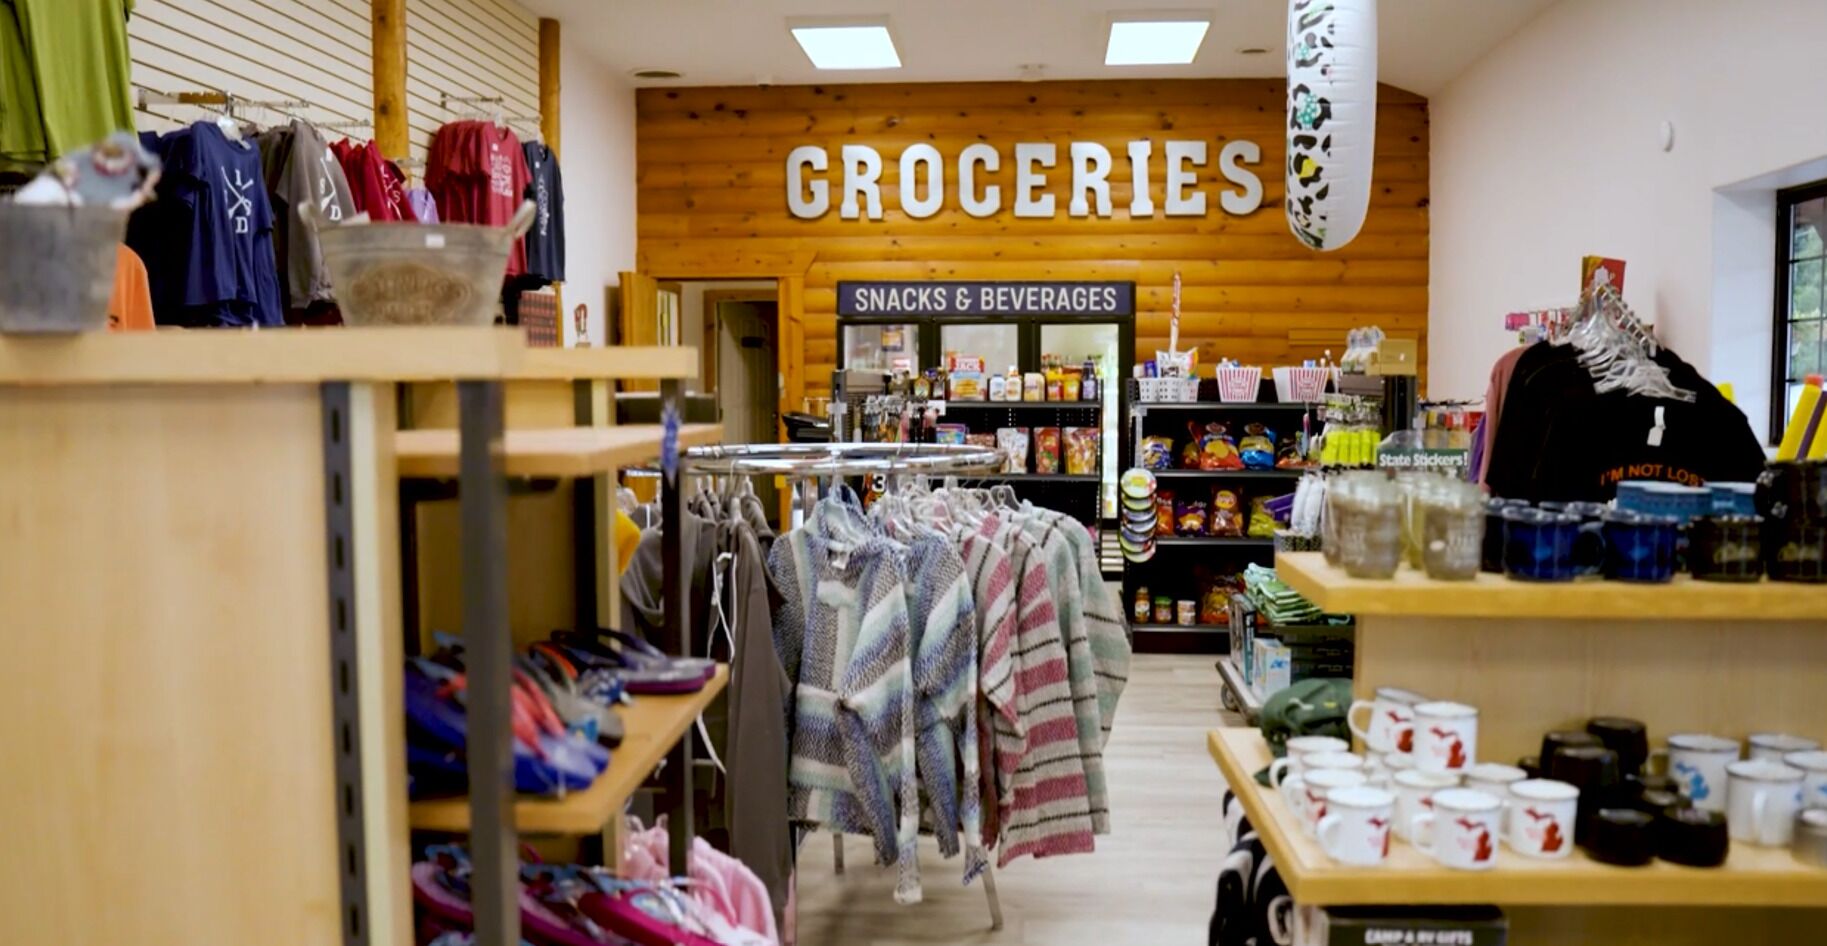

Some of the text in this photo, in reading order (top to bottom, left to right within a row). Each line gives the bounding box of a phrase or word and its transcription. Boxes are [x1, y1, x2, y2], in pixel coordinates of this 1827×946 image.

[786, 140, 1264, 219] GROCERIES
[855, 286, 1117, 312] SNACKS & BEVERAGES
[1379, 451, 1468, 467] State Stickers!
[1600, 466, 1625, 486] I'M
[1628, 463, 1663, 478] NOT
